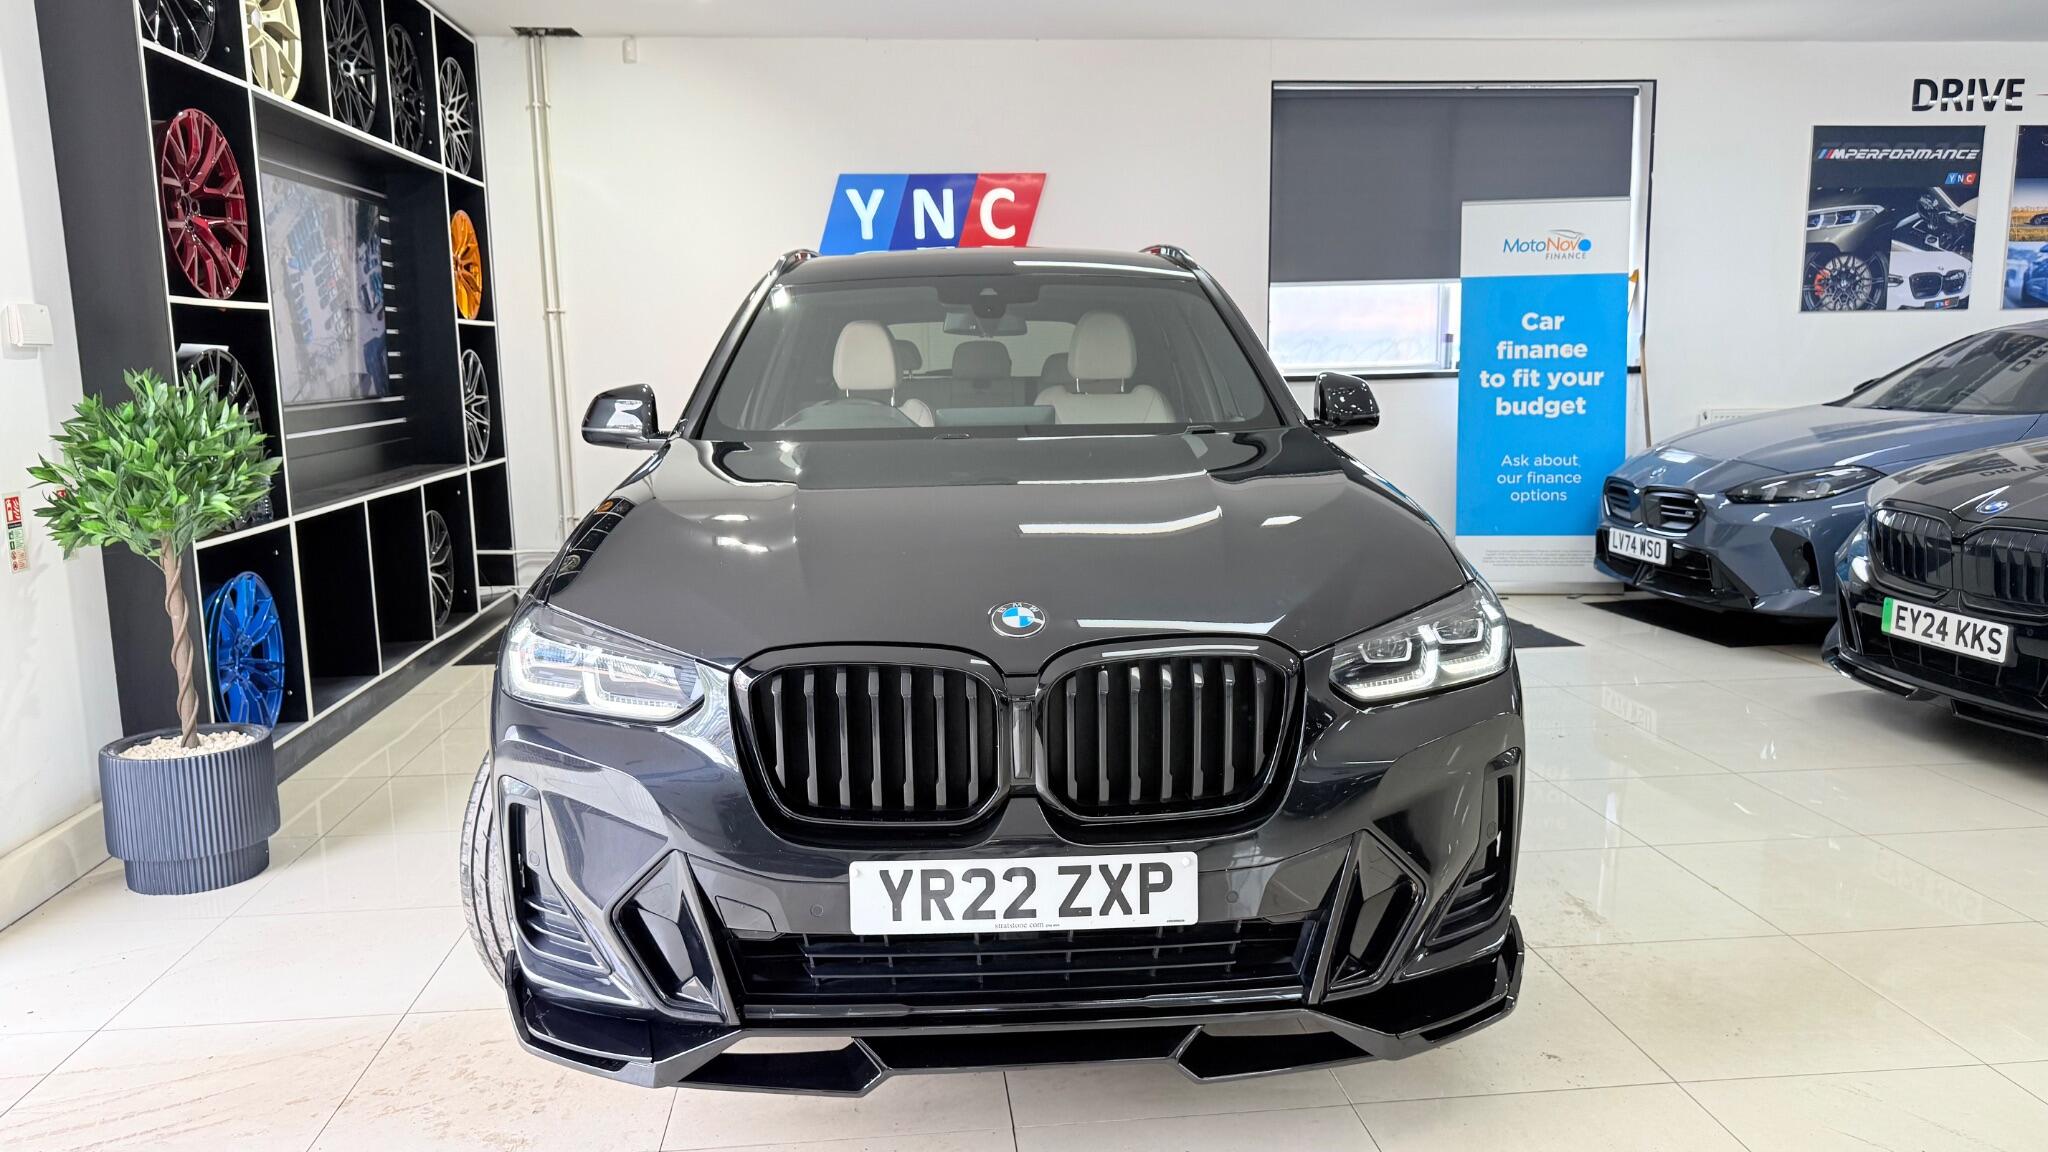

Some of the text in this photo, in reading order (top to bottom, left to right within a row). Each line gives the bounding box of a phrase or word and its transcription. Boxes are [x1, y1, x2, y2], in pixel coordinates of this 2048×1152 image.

[1911, 78, 2026, 112] DRIVE
[1949, 174, 1974, 184] YNC
[845, 188, 1016, 240] YNC
[1545, 252, 1587, 260] FINANCE
[1521, 312, 1565, 331] Car
[1496, 340, 1588, 359] finance
[1479, 368, 1605, 391] to fit your
[1495, 396, 1587, 418] budget
[1501, 454, 1579, 467] Ask about
[1496, 471, 1582, 484] our finance
[1510, 488, 1568, 503] options
[1612, 532, 1662, 559] LV74 WSO
[1894, 604, 2004, 655] EY24 KKS
[879, 861, 1173, 922] YR22 ZXP
